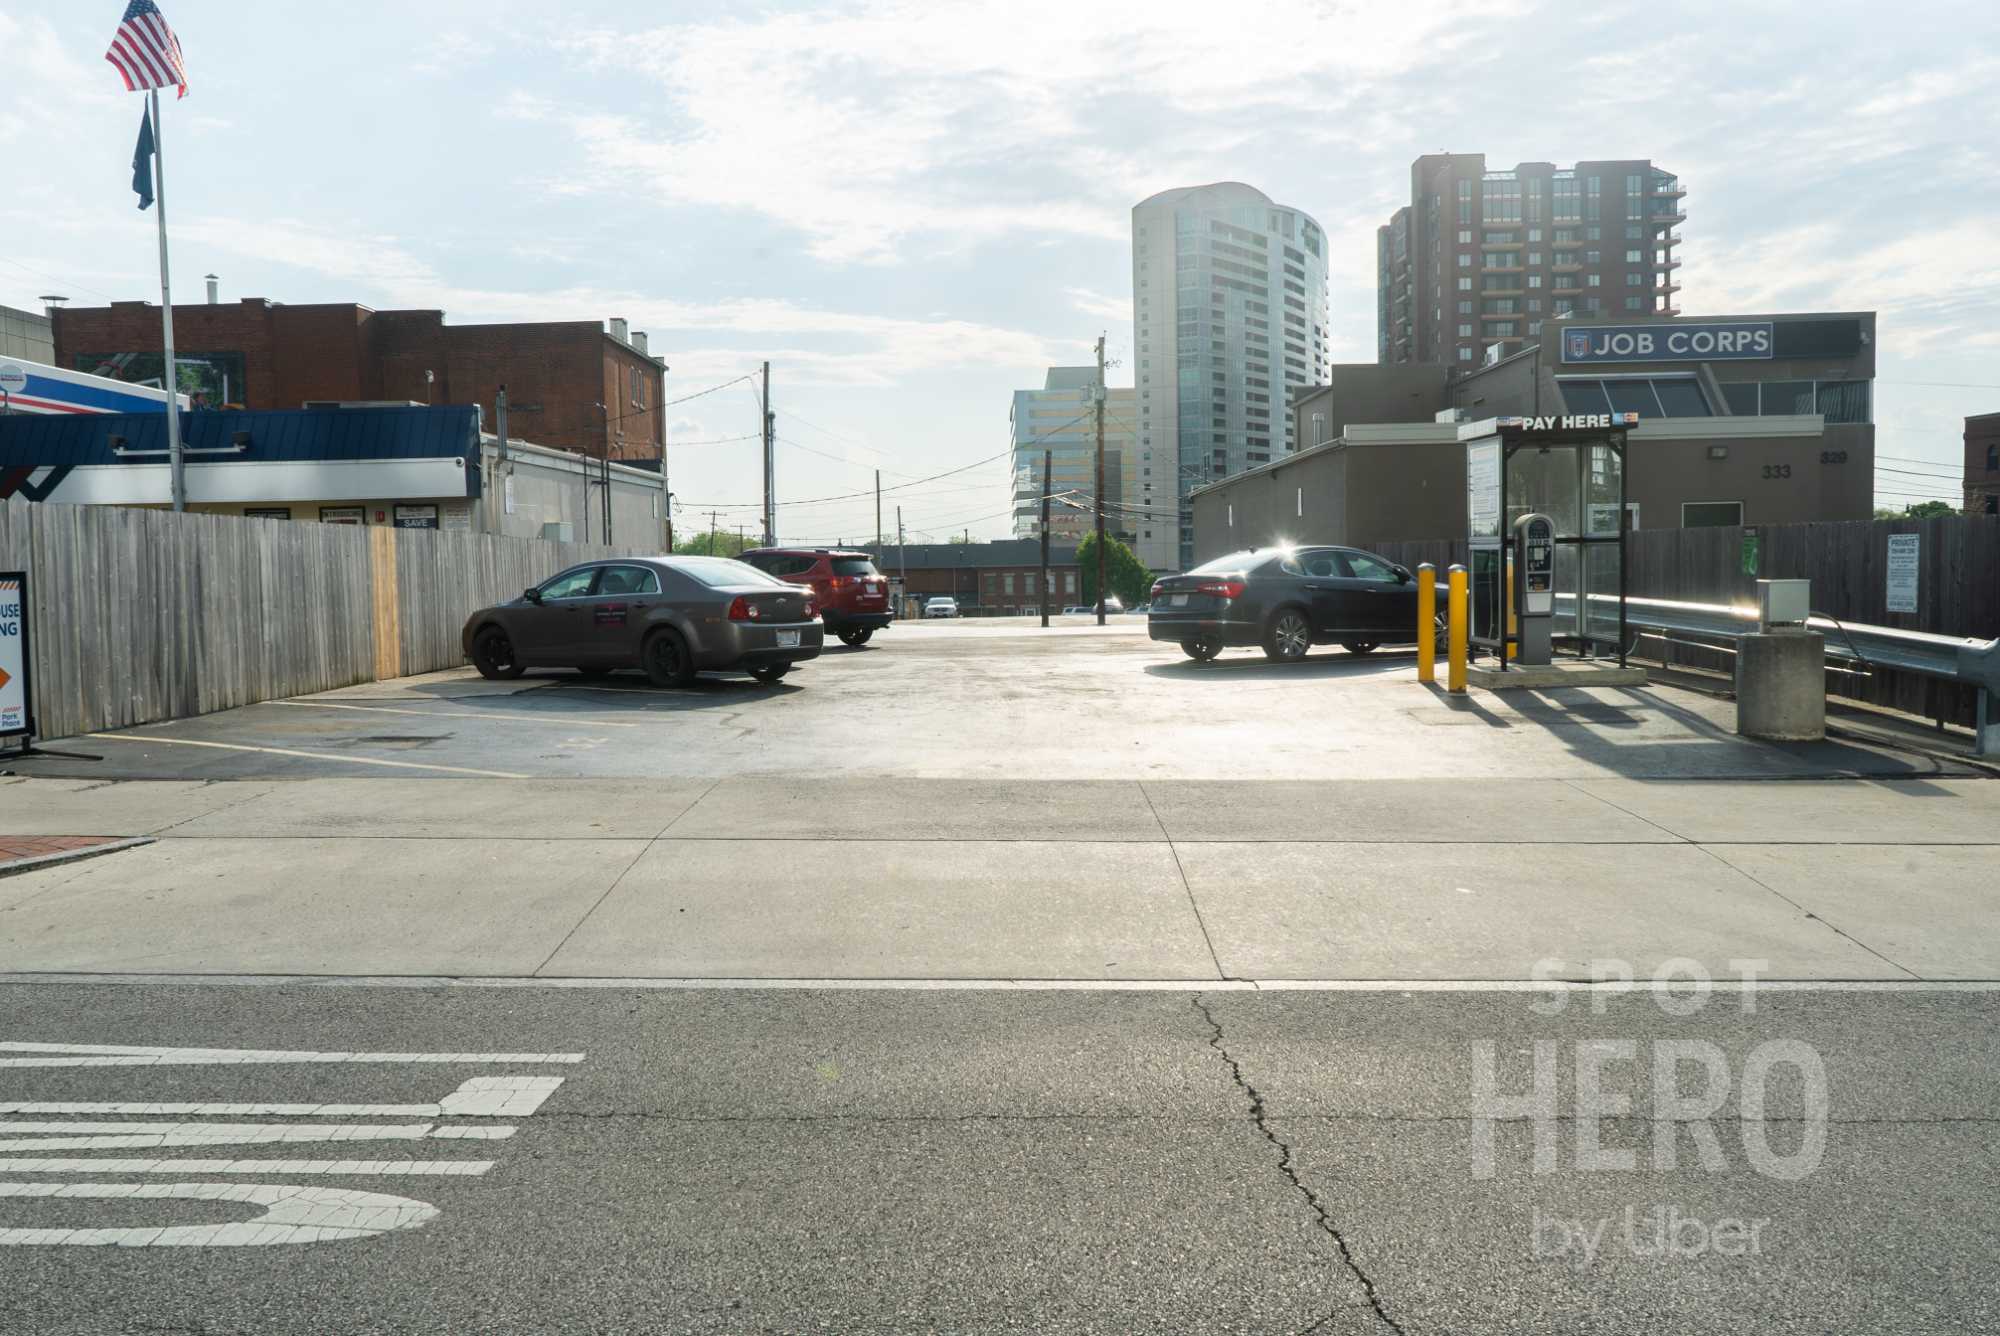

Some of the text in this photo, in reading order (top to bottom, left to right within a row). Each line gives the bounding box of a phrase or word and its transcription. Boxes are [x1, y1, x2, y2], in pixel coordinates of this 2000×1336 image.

[1594, 329, 1769, 356] JOB CORPS
[1522, 416, 1557, 431] PAY
[1561, 414, 1610, 430] HERE
[1761, 464, 1791, 480] 333
[403, 518, 429, 528] SAVE
